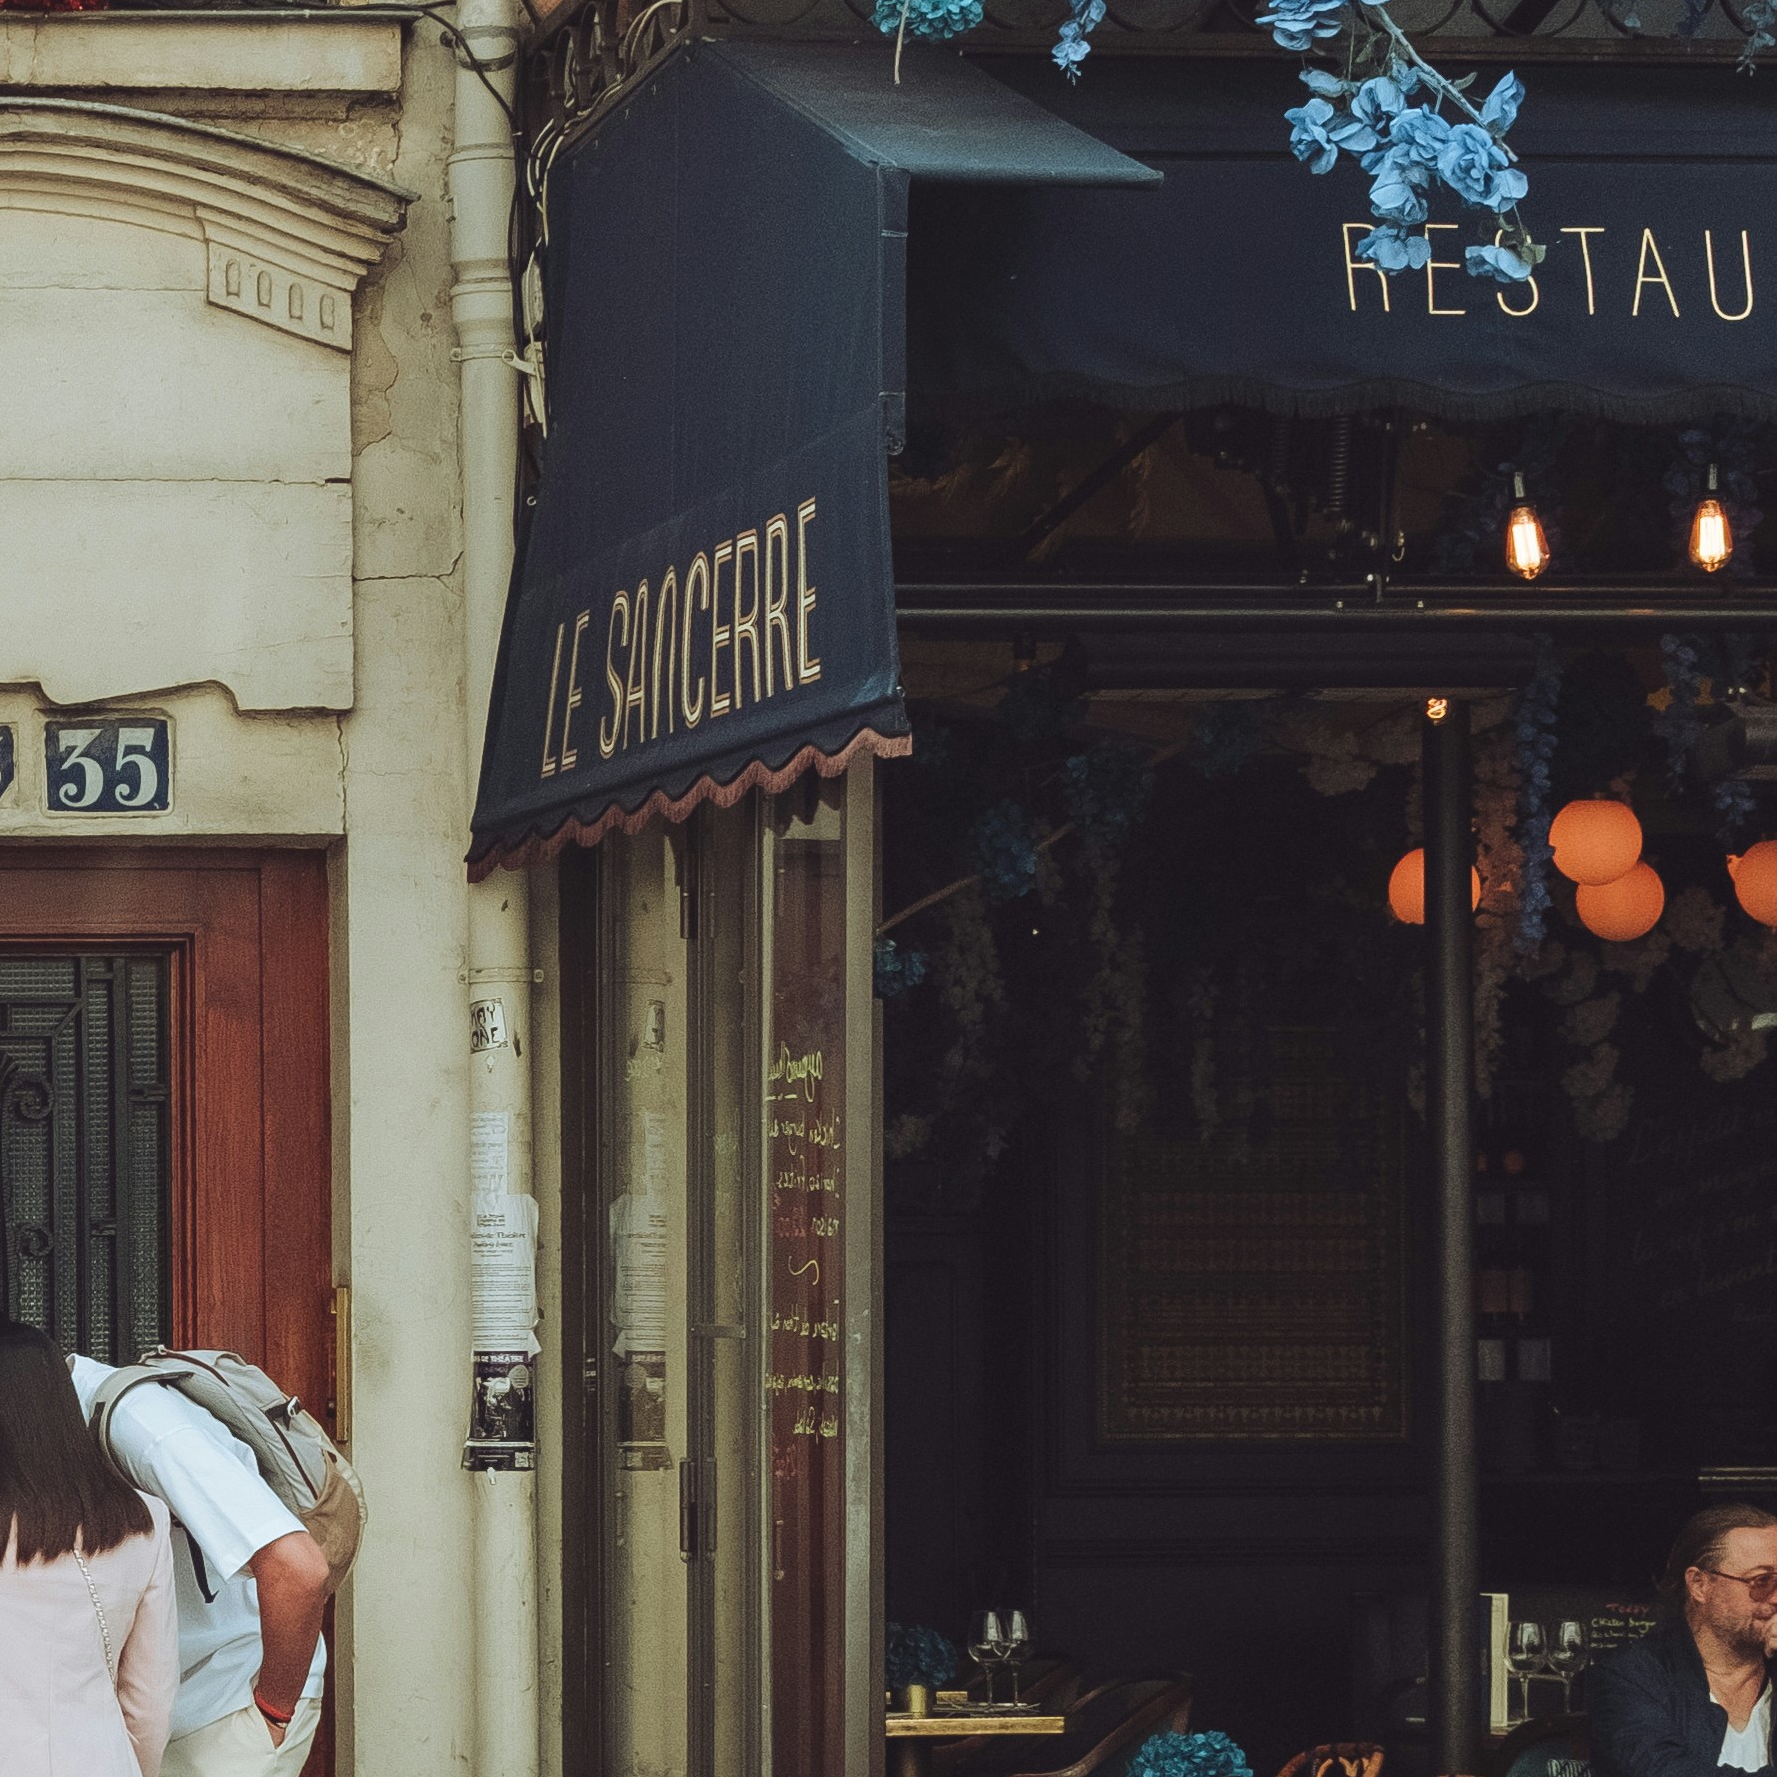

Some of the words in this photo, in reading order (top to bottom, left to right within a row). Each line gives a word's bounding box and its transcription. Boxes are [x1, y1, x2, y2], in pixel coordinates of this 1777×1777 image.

[540, 609, 590, 778] LE
[599, 496, 821, 759] SANCERRE
[59, 728, 158, 807] 35
